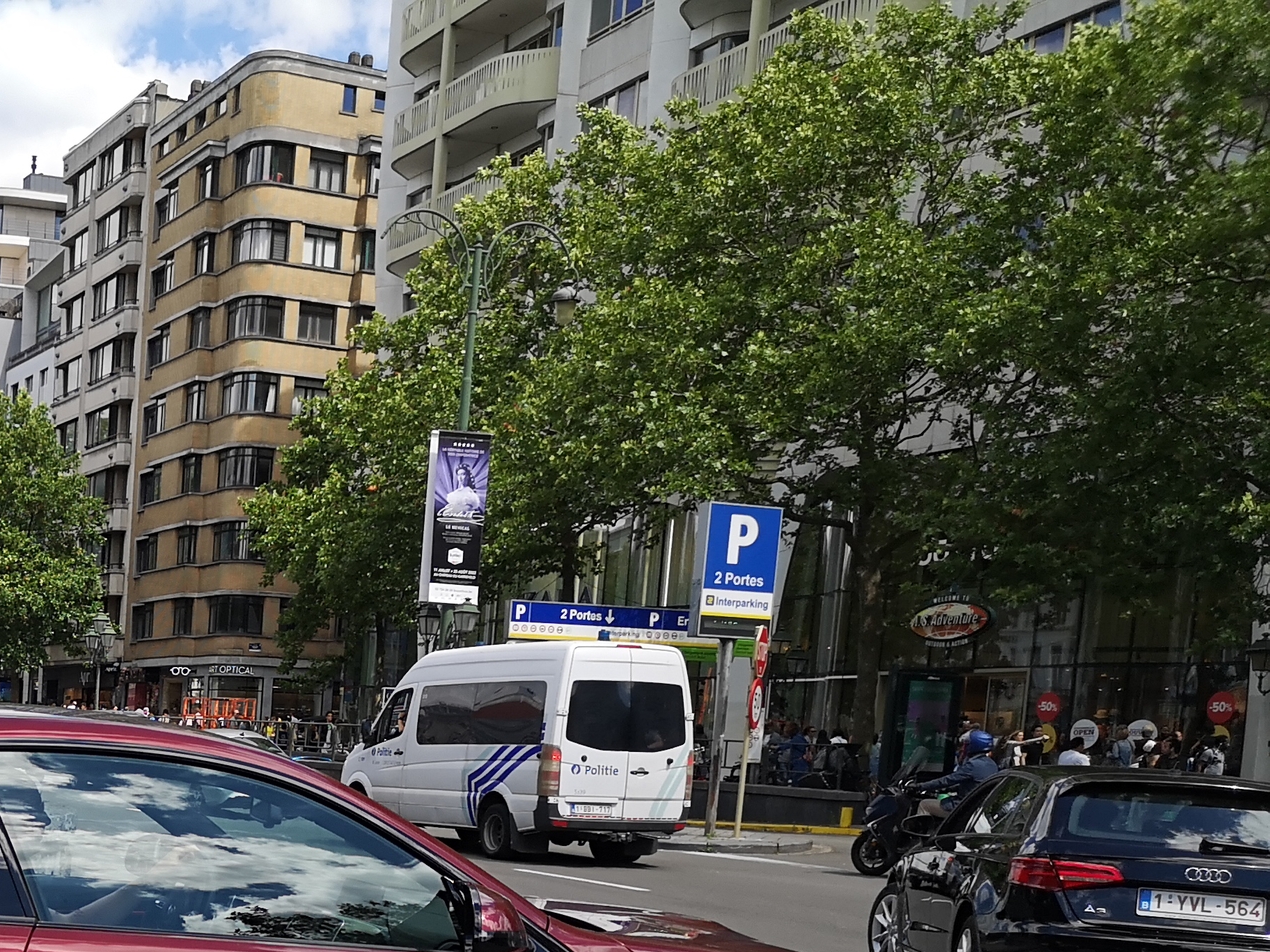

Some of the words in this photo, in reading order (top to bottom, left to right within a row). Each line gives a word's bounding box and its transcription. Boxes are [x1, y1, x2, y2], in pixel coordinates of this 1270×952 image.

[726, 514, 759, 565] P
[714, 571, 722, 584] 2
[725, 572, 764, 587] Portes
[716, 596, 768, 611] Interparking
[515, 604, 526, 620] P
[560, 609, 568, 620] 2
[570, 610, 602, 621] Portes
[649, 612, 660, 627] P
[219, 665, 254, 675] OPTICAL
[1038, 701, 1057, 711] -50%
[1209, 702, 1232, 712] -50%
[585, 765, 619, 776] Politie
[1084, 904, 1106, 914] A3
